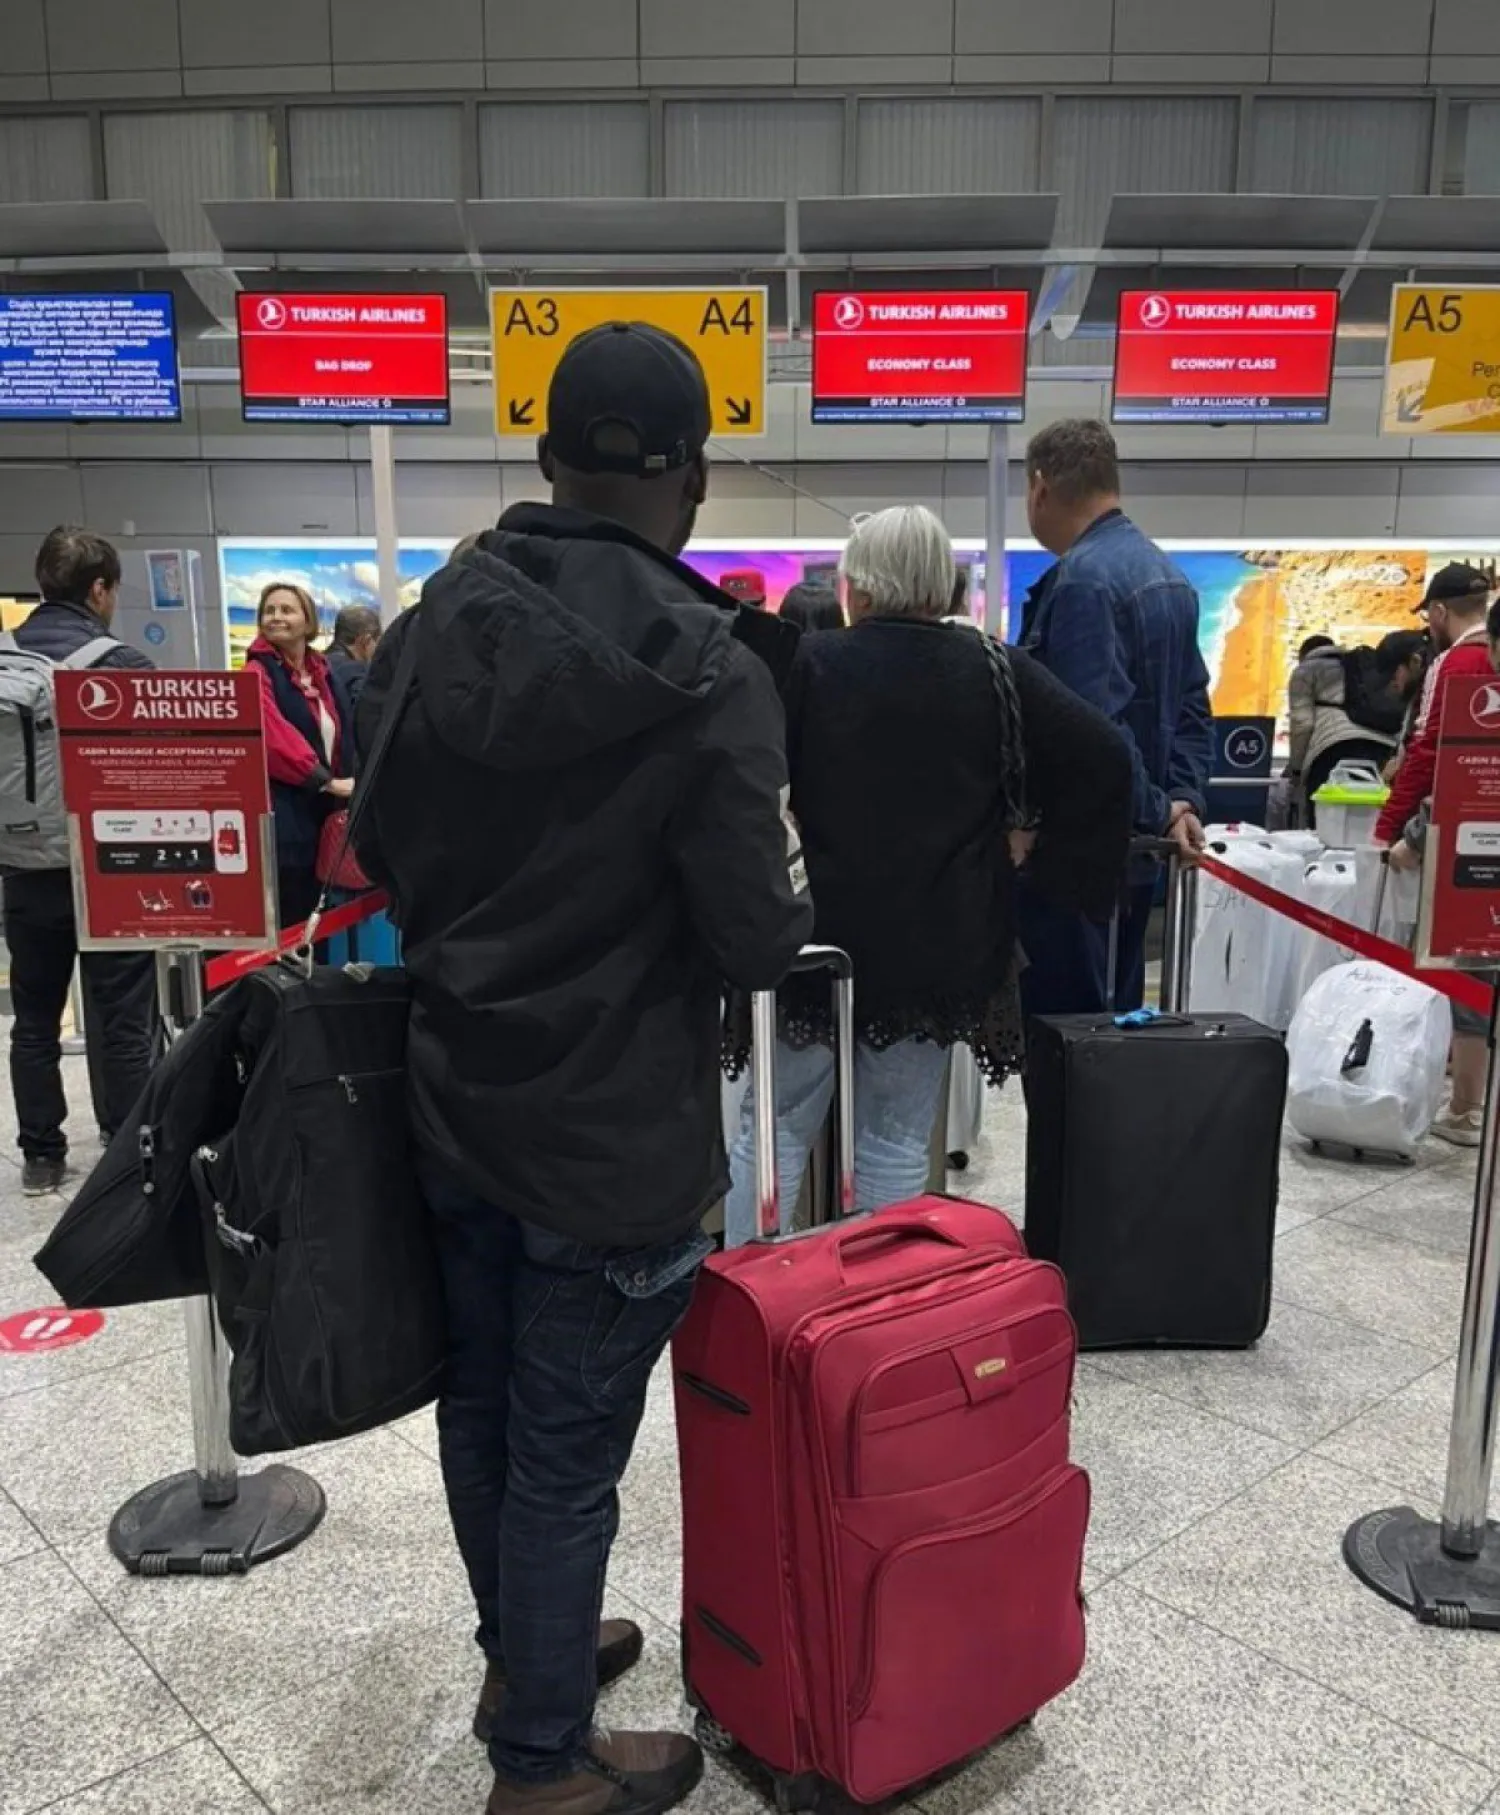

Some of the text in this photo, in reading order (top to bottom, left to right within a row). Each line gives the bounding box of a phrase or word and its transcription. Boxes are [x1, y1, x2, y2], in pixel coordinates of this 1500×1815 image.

[291, 307, 426, 323] TURKISH AIRLINES
[504, 297, 754, 336] A3 A4
[869, 305, 1008, 320] TURKISH AIRLINES
[1175, 305, 1316, 319] TURKISH AIRLINES
[1403, 294, 1463, 333] A5
[314, 360, 372, 371] BAG DROP
[867, 358, 972, 371] ECONOMY CLASS
[1170, 358, 1277, 370] ECONOMY CLASS
[298, 398, 379, 407] STAR ALLIANCE
[870, 397, 953, 407] STAR ALLIANCE
[1172, 397, 1256, 406] STAR ALLIANCE
[131, 679, 236, 698] TURKISH
[133, 700, 239, 719] AIRLINES
[1235, 740, 1259, 755] A5
[157, 849, 167, 861] 2
[190, 849, 199, 861] 1
